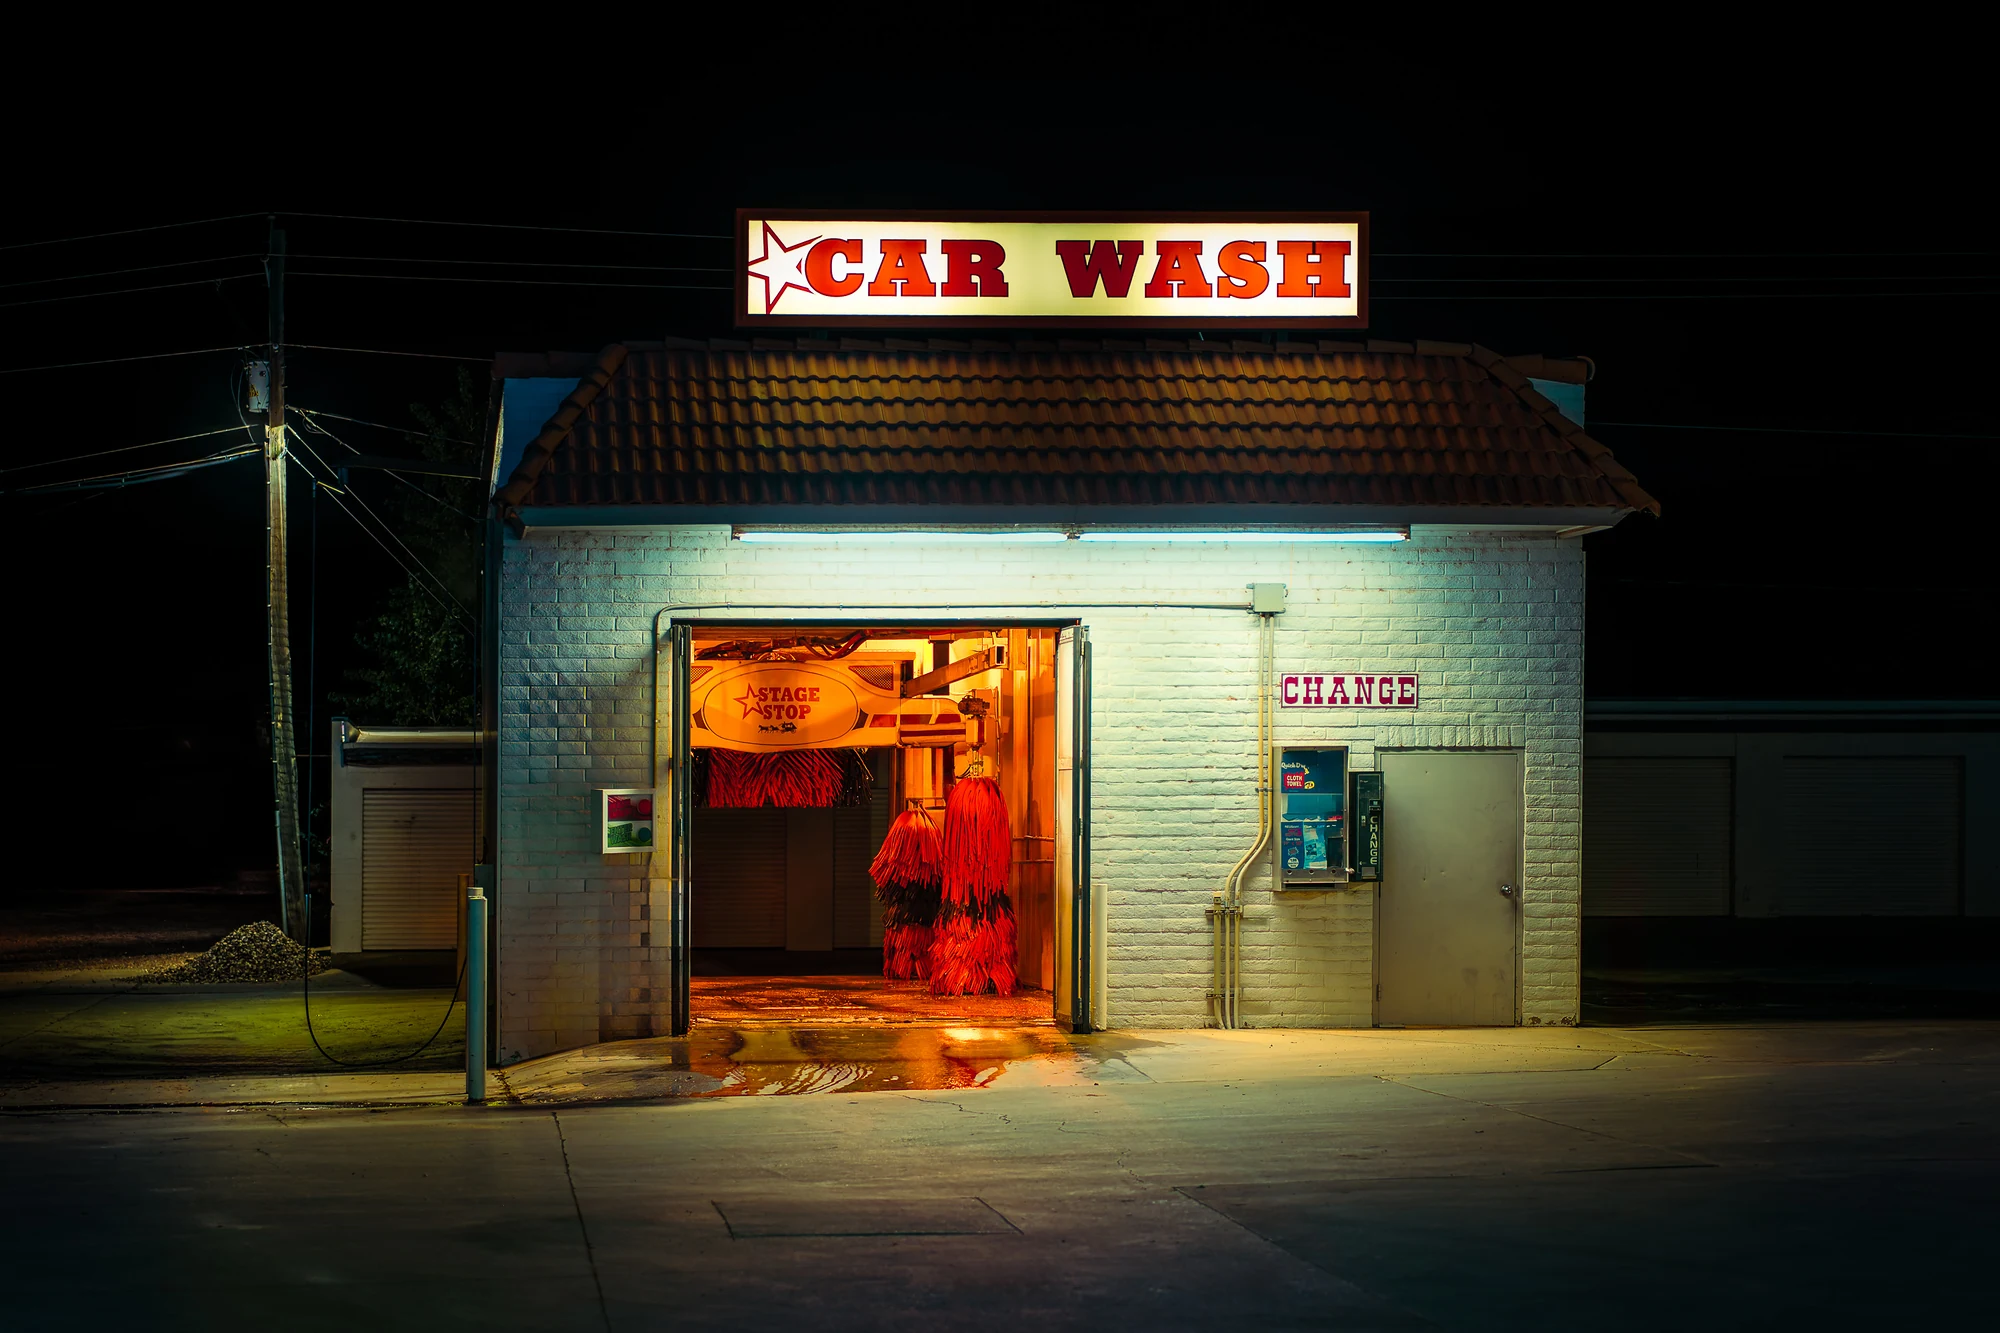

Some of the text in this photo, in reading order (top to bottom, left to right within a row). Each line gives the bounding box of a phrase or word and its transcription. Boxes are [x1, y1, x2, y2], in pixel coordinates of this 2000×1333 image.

[804, 238, 1352, 299] CAR WASH
[757, 687, 820, 702] STAGE
[1284, 676, 1416, 705] CHANGE
[762, 705, 811, 720] STOP
[1370, 815, 1378, 865] CHANGE
